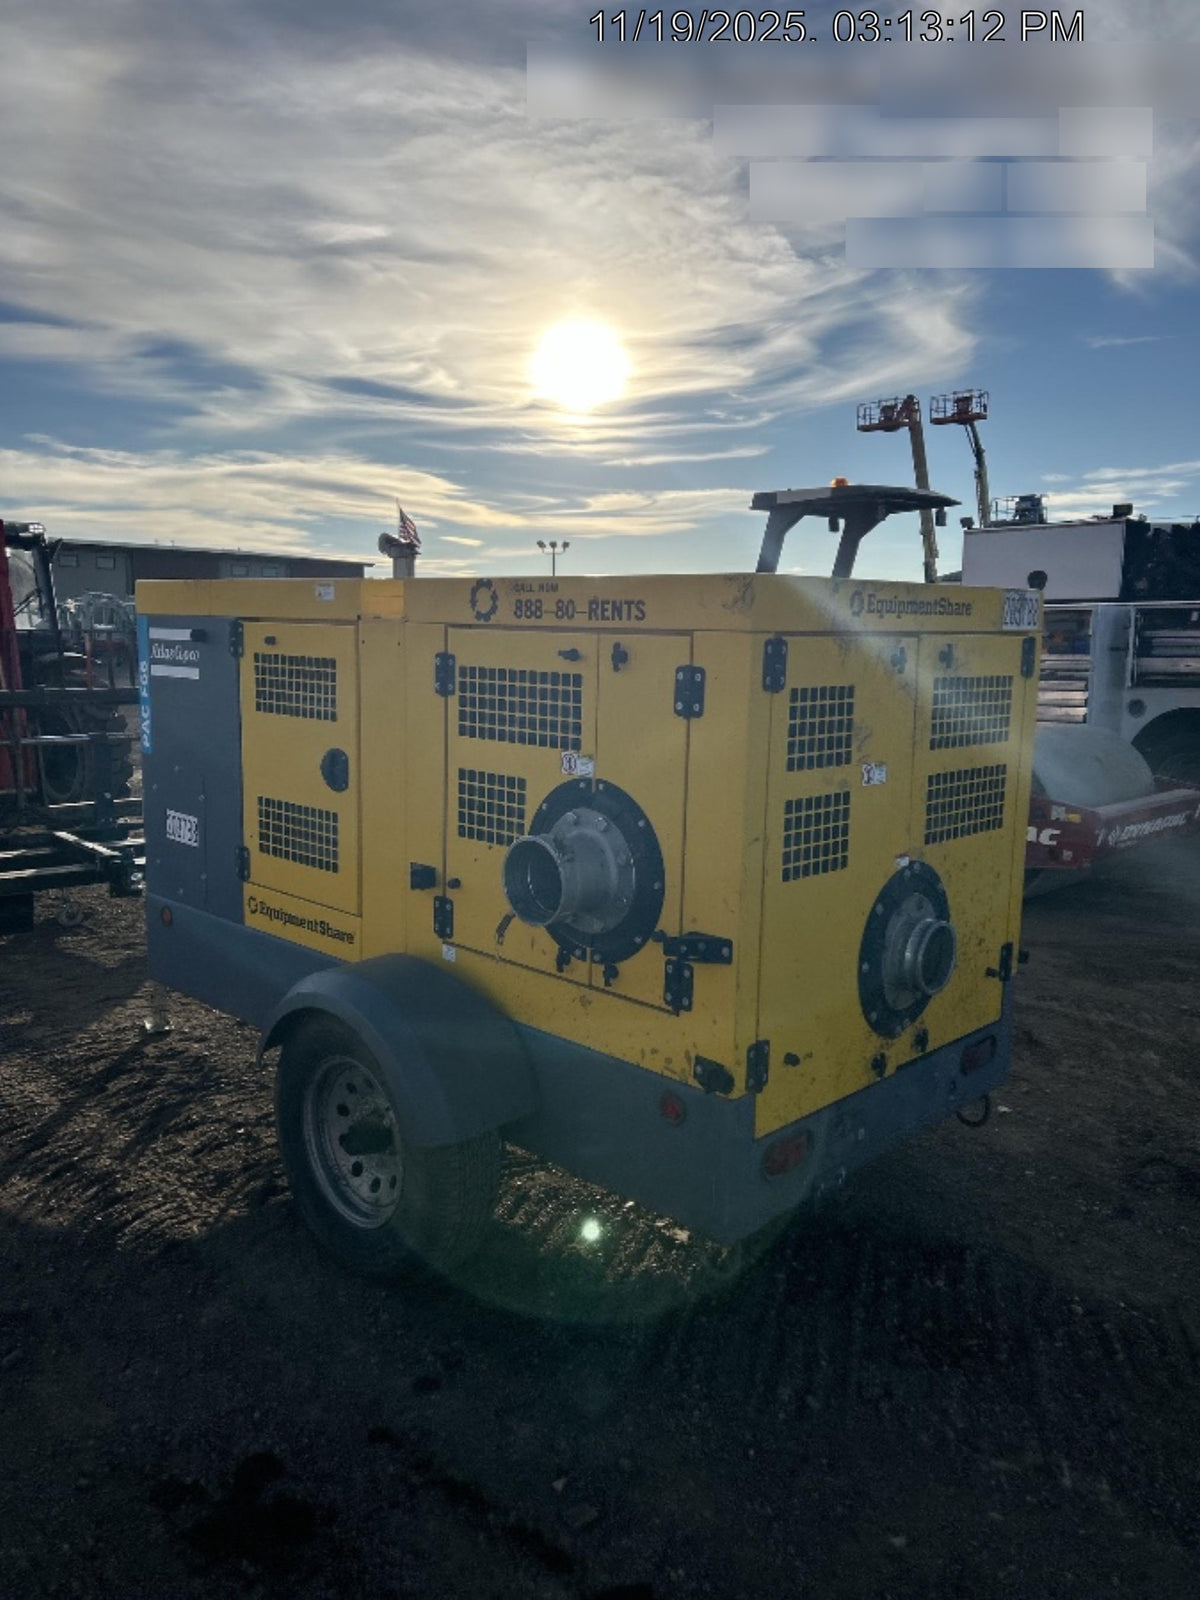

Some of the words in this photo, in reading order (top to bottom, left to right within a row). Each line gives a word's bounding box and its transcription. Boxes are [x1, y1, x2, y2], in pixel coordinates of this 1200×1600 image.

[514, 598, 646, 622] 888-80-RENTS
[866, 594, 972, 618] EquipmentShare
[141, 704, 151, 748] PAC
[259, 901, 354, 944] EquipmentShare
